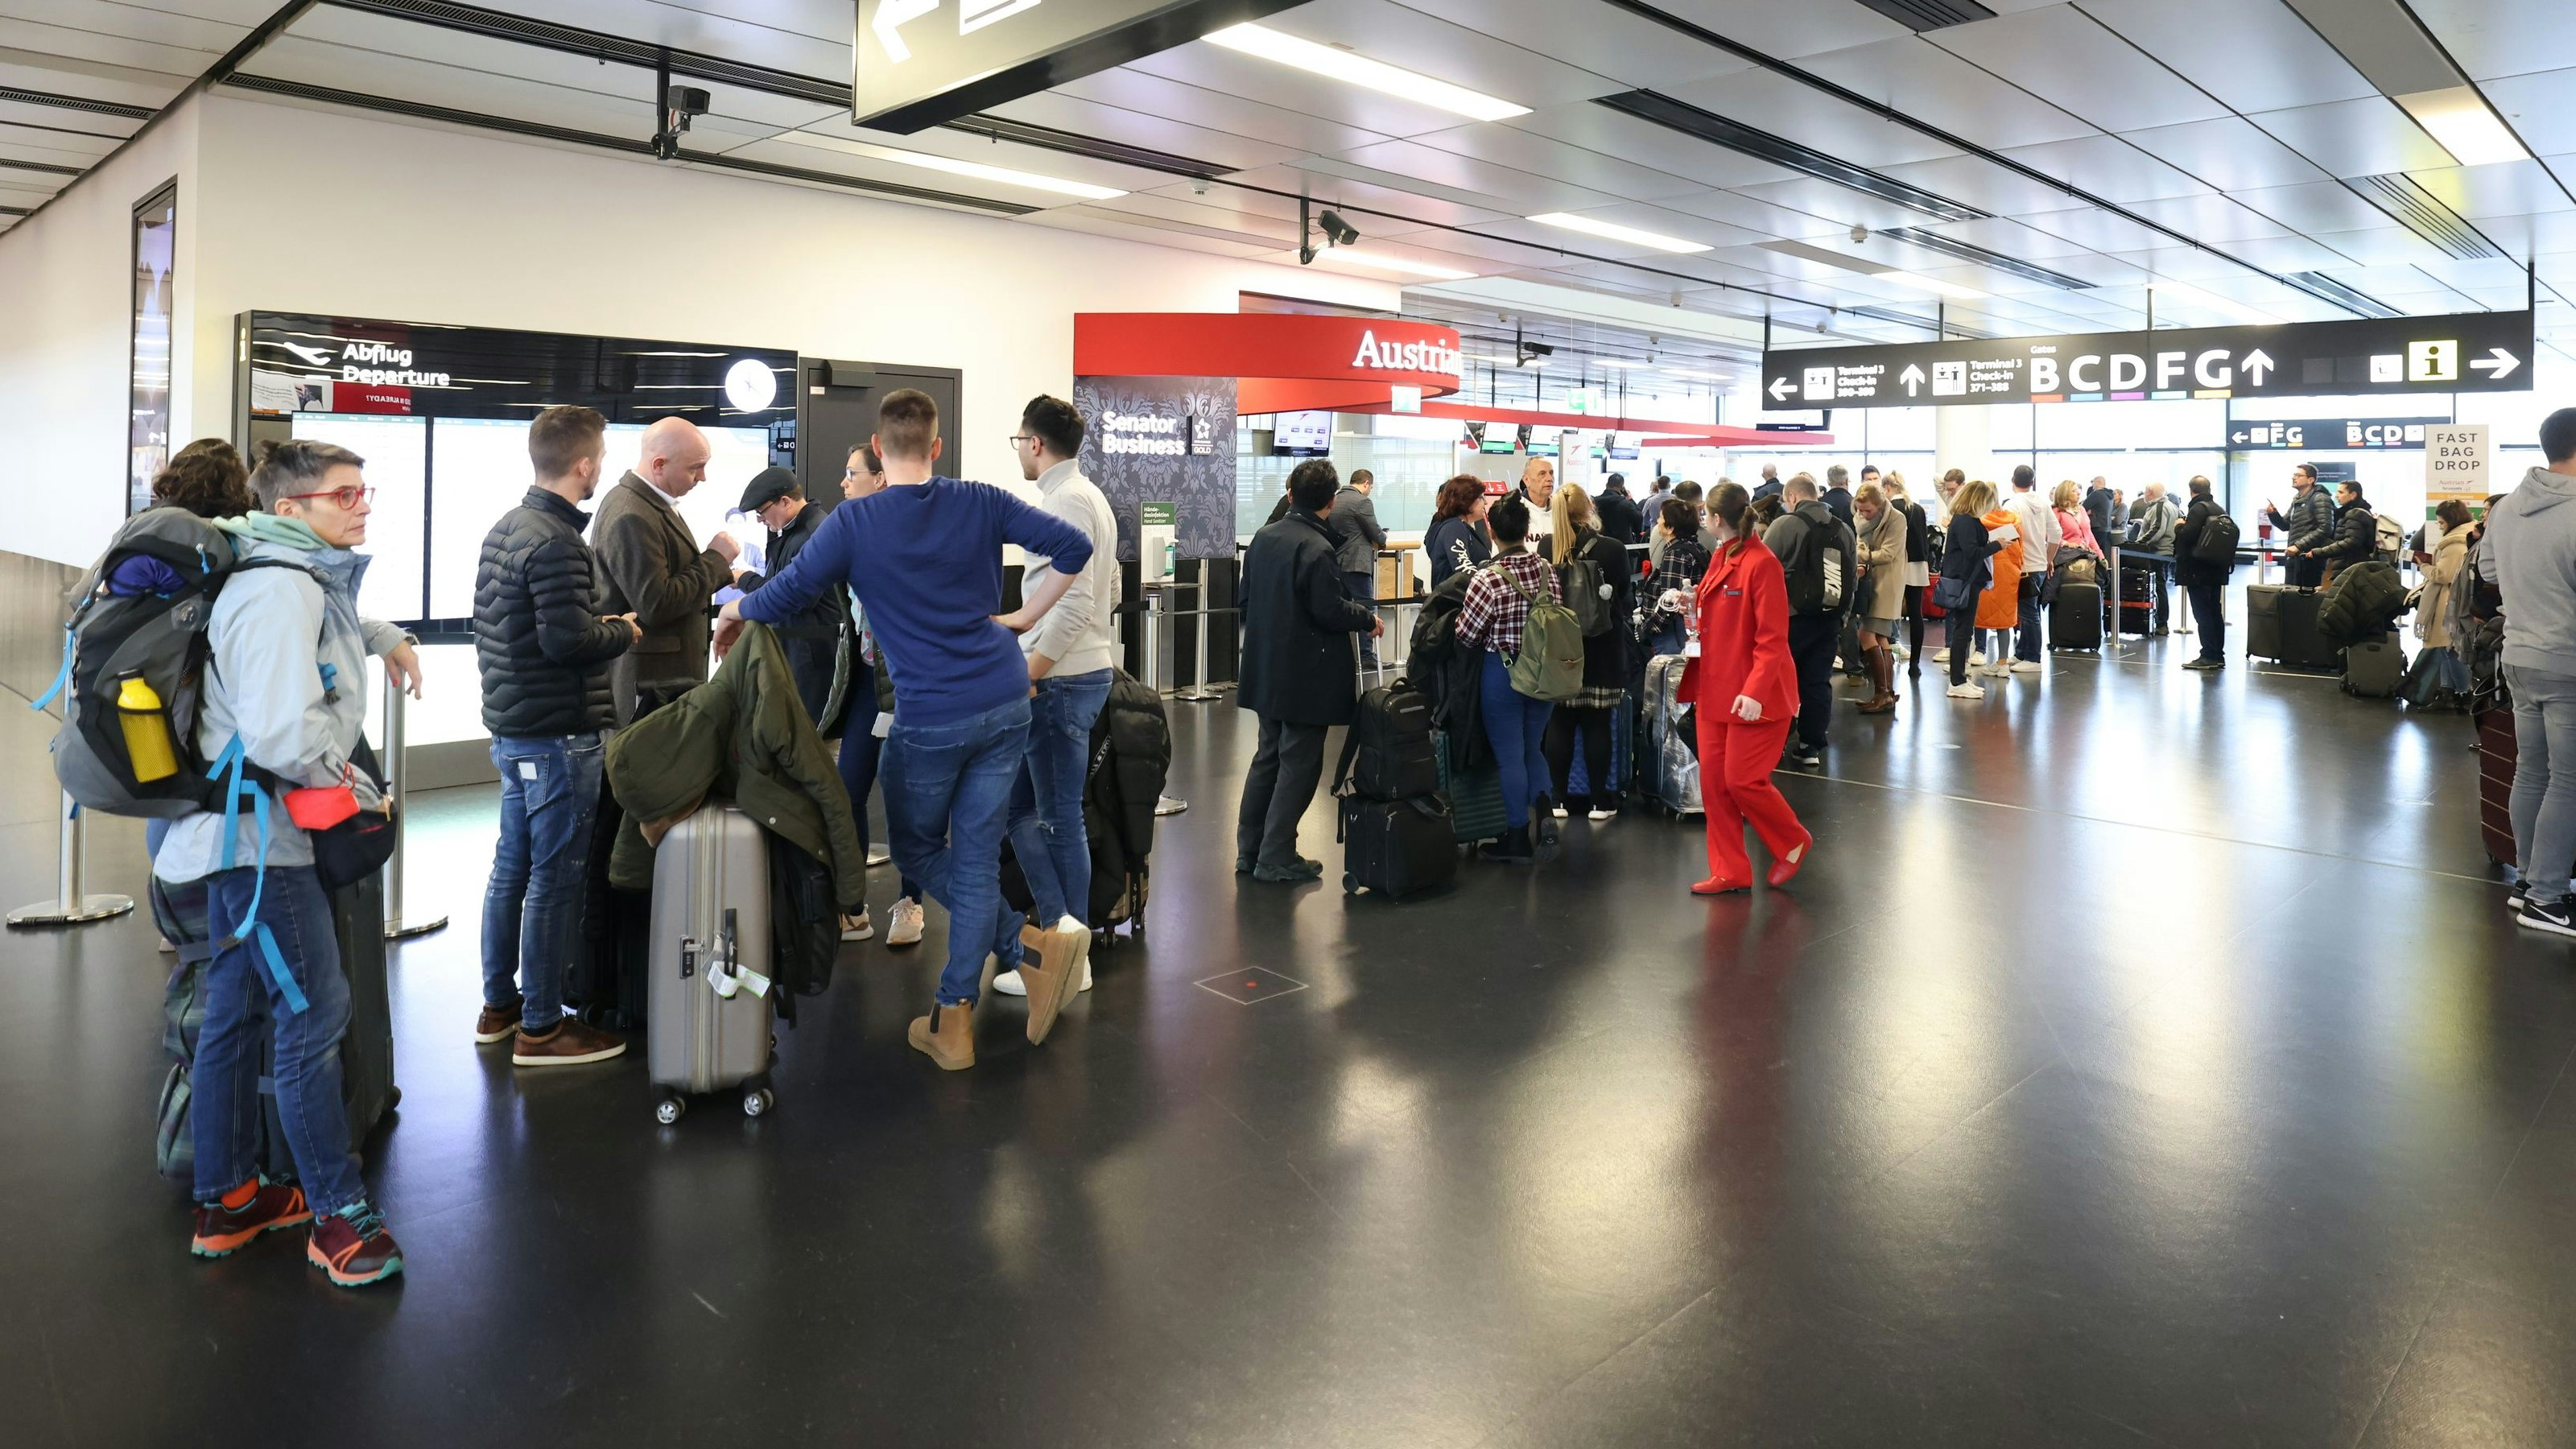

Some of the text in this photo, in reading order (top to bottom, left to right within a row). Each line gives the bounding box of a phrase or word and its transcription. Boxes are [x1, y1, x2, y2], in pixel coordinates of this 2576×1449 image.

[342, 344, 412, 367] Abflug
[1352, 330, 1463, 378] Austrian
[1970, 358, 2022, 370] Terminal 3
[342, 365, 451, 387] Departure
[1837, 365, 1885, 376] Terminal 3
[1970, 370, 2014, 382] Check-in
[1837, 375, 1877, 387] Check-in
[1102, 411, 1177, 434] Senator
[2437, 433, 2478, 443] FAST
[1102, 433, 1186, 456] Business
[2440, 447, 2474, 456] BAG
[2435, 460, 2480, 470] DROP
[1823, 557, 1842, 600] NIKE
